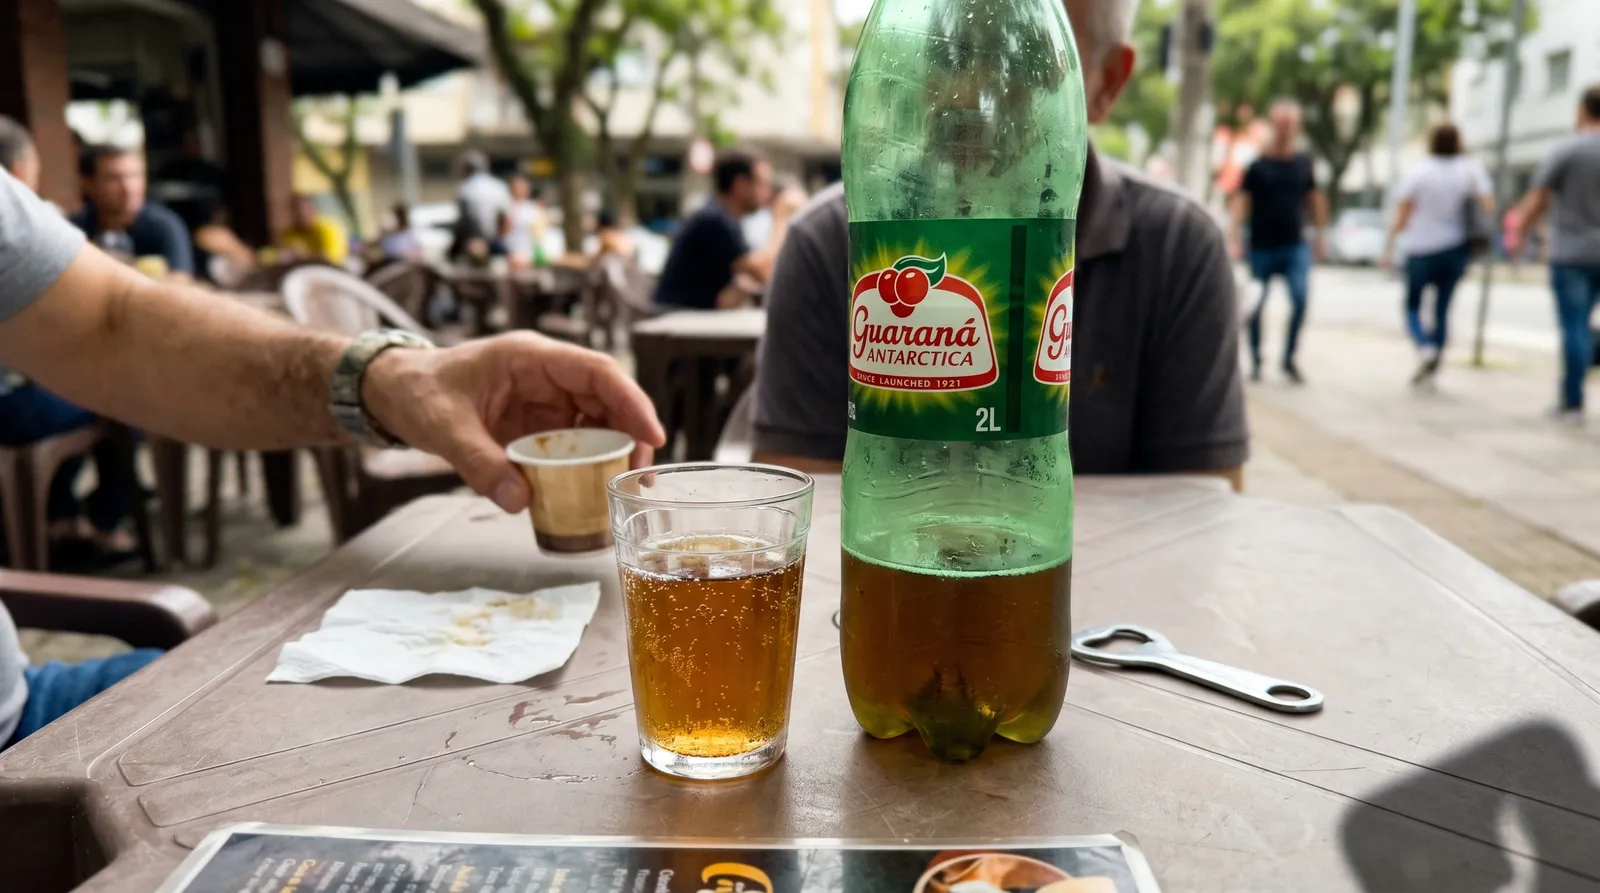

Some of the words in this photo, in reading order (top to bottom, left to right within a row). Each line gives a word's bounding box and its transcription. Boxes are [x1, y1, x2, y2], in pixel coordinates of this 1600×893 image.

[853, 305, 980, 359] Guaraná
[866, 348, 974, 366] ANTARCTICA
[879, 377, 931, 388] LAUNCHED
[937, 379, 960, 388] 1921
[975, 407, 1001, 432] 2L
